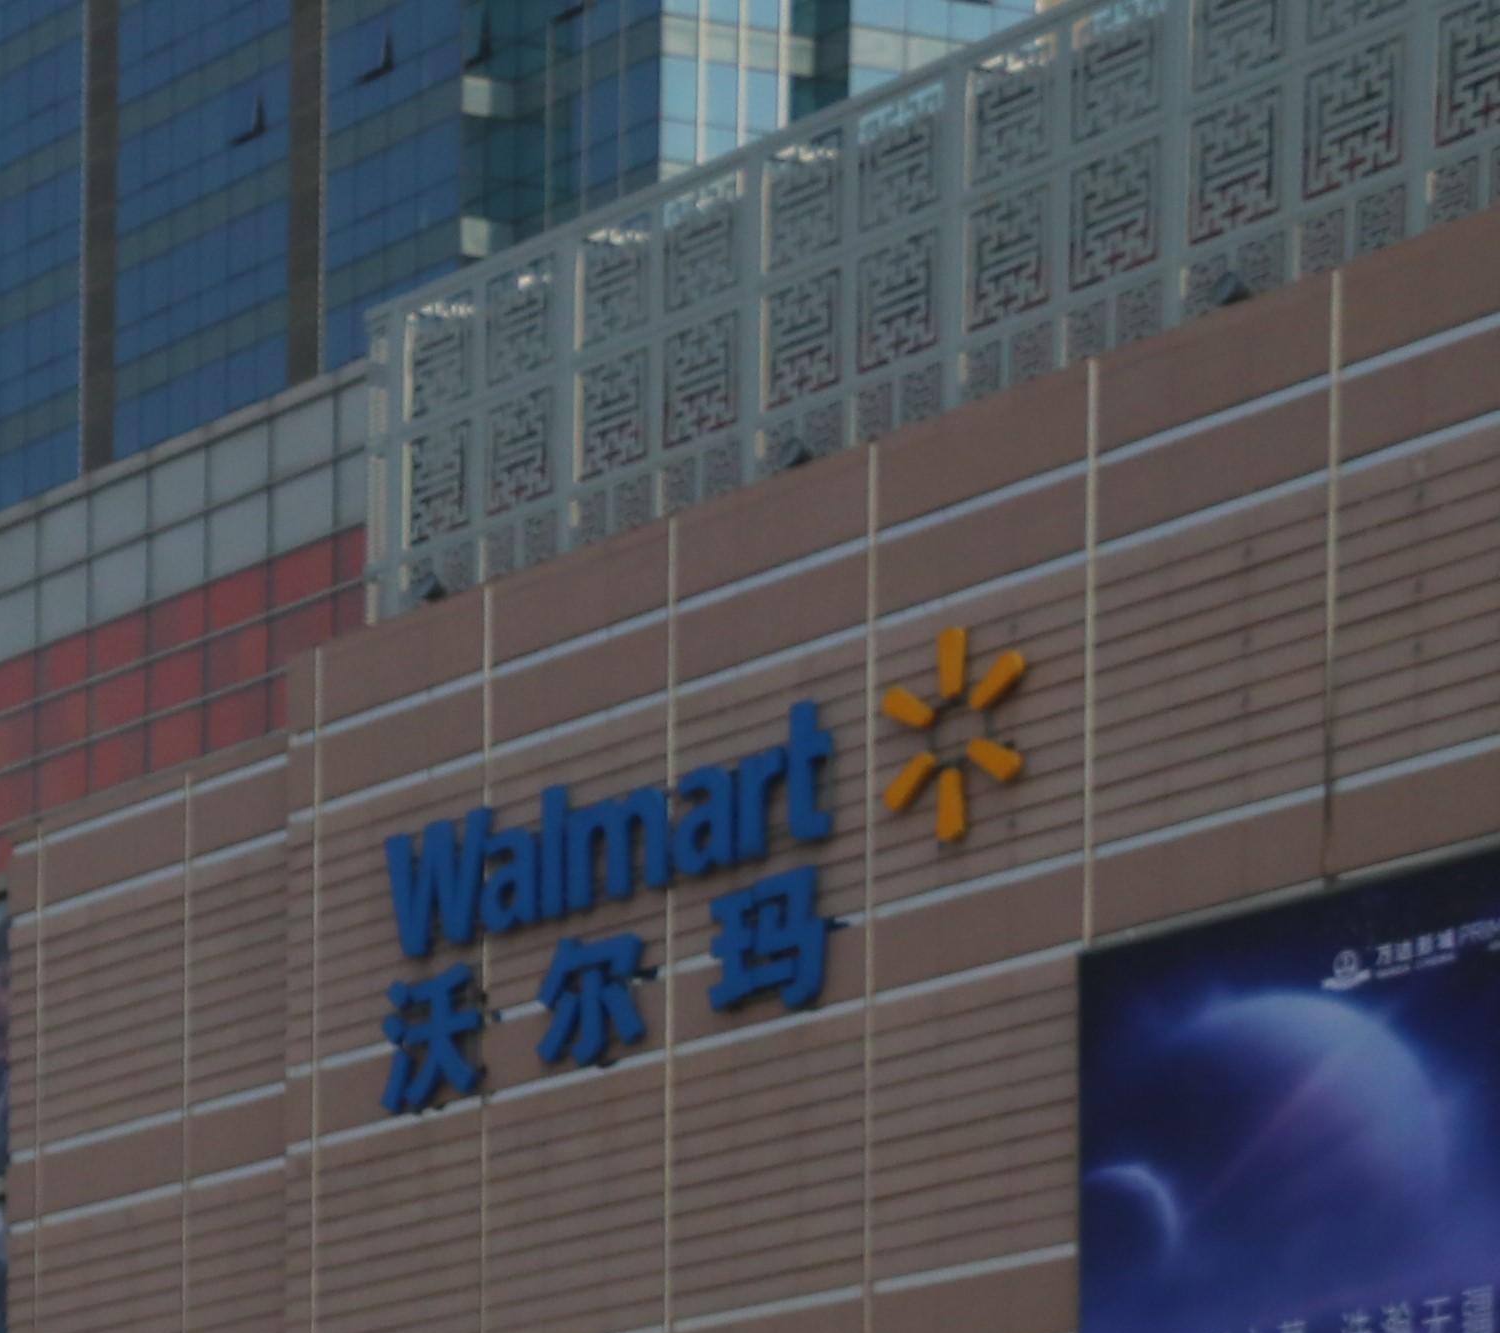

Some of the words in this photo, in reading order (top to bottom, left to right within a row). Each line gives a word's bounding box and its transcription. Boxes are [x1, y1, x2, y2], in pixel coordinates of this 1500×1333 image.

[384, 700, 834, 957] Walmart
[381, 866, 831, 1113] 沃尔玛
